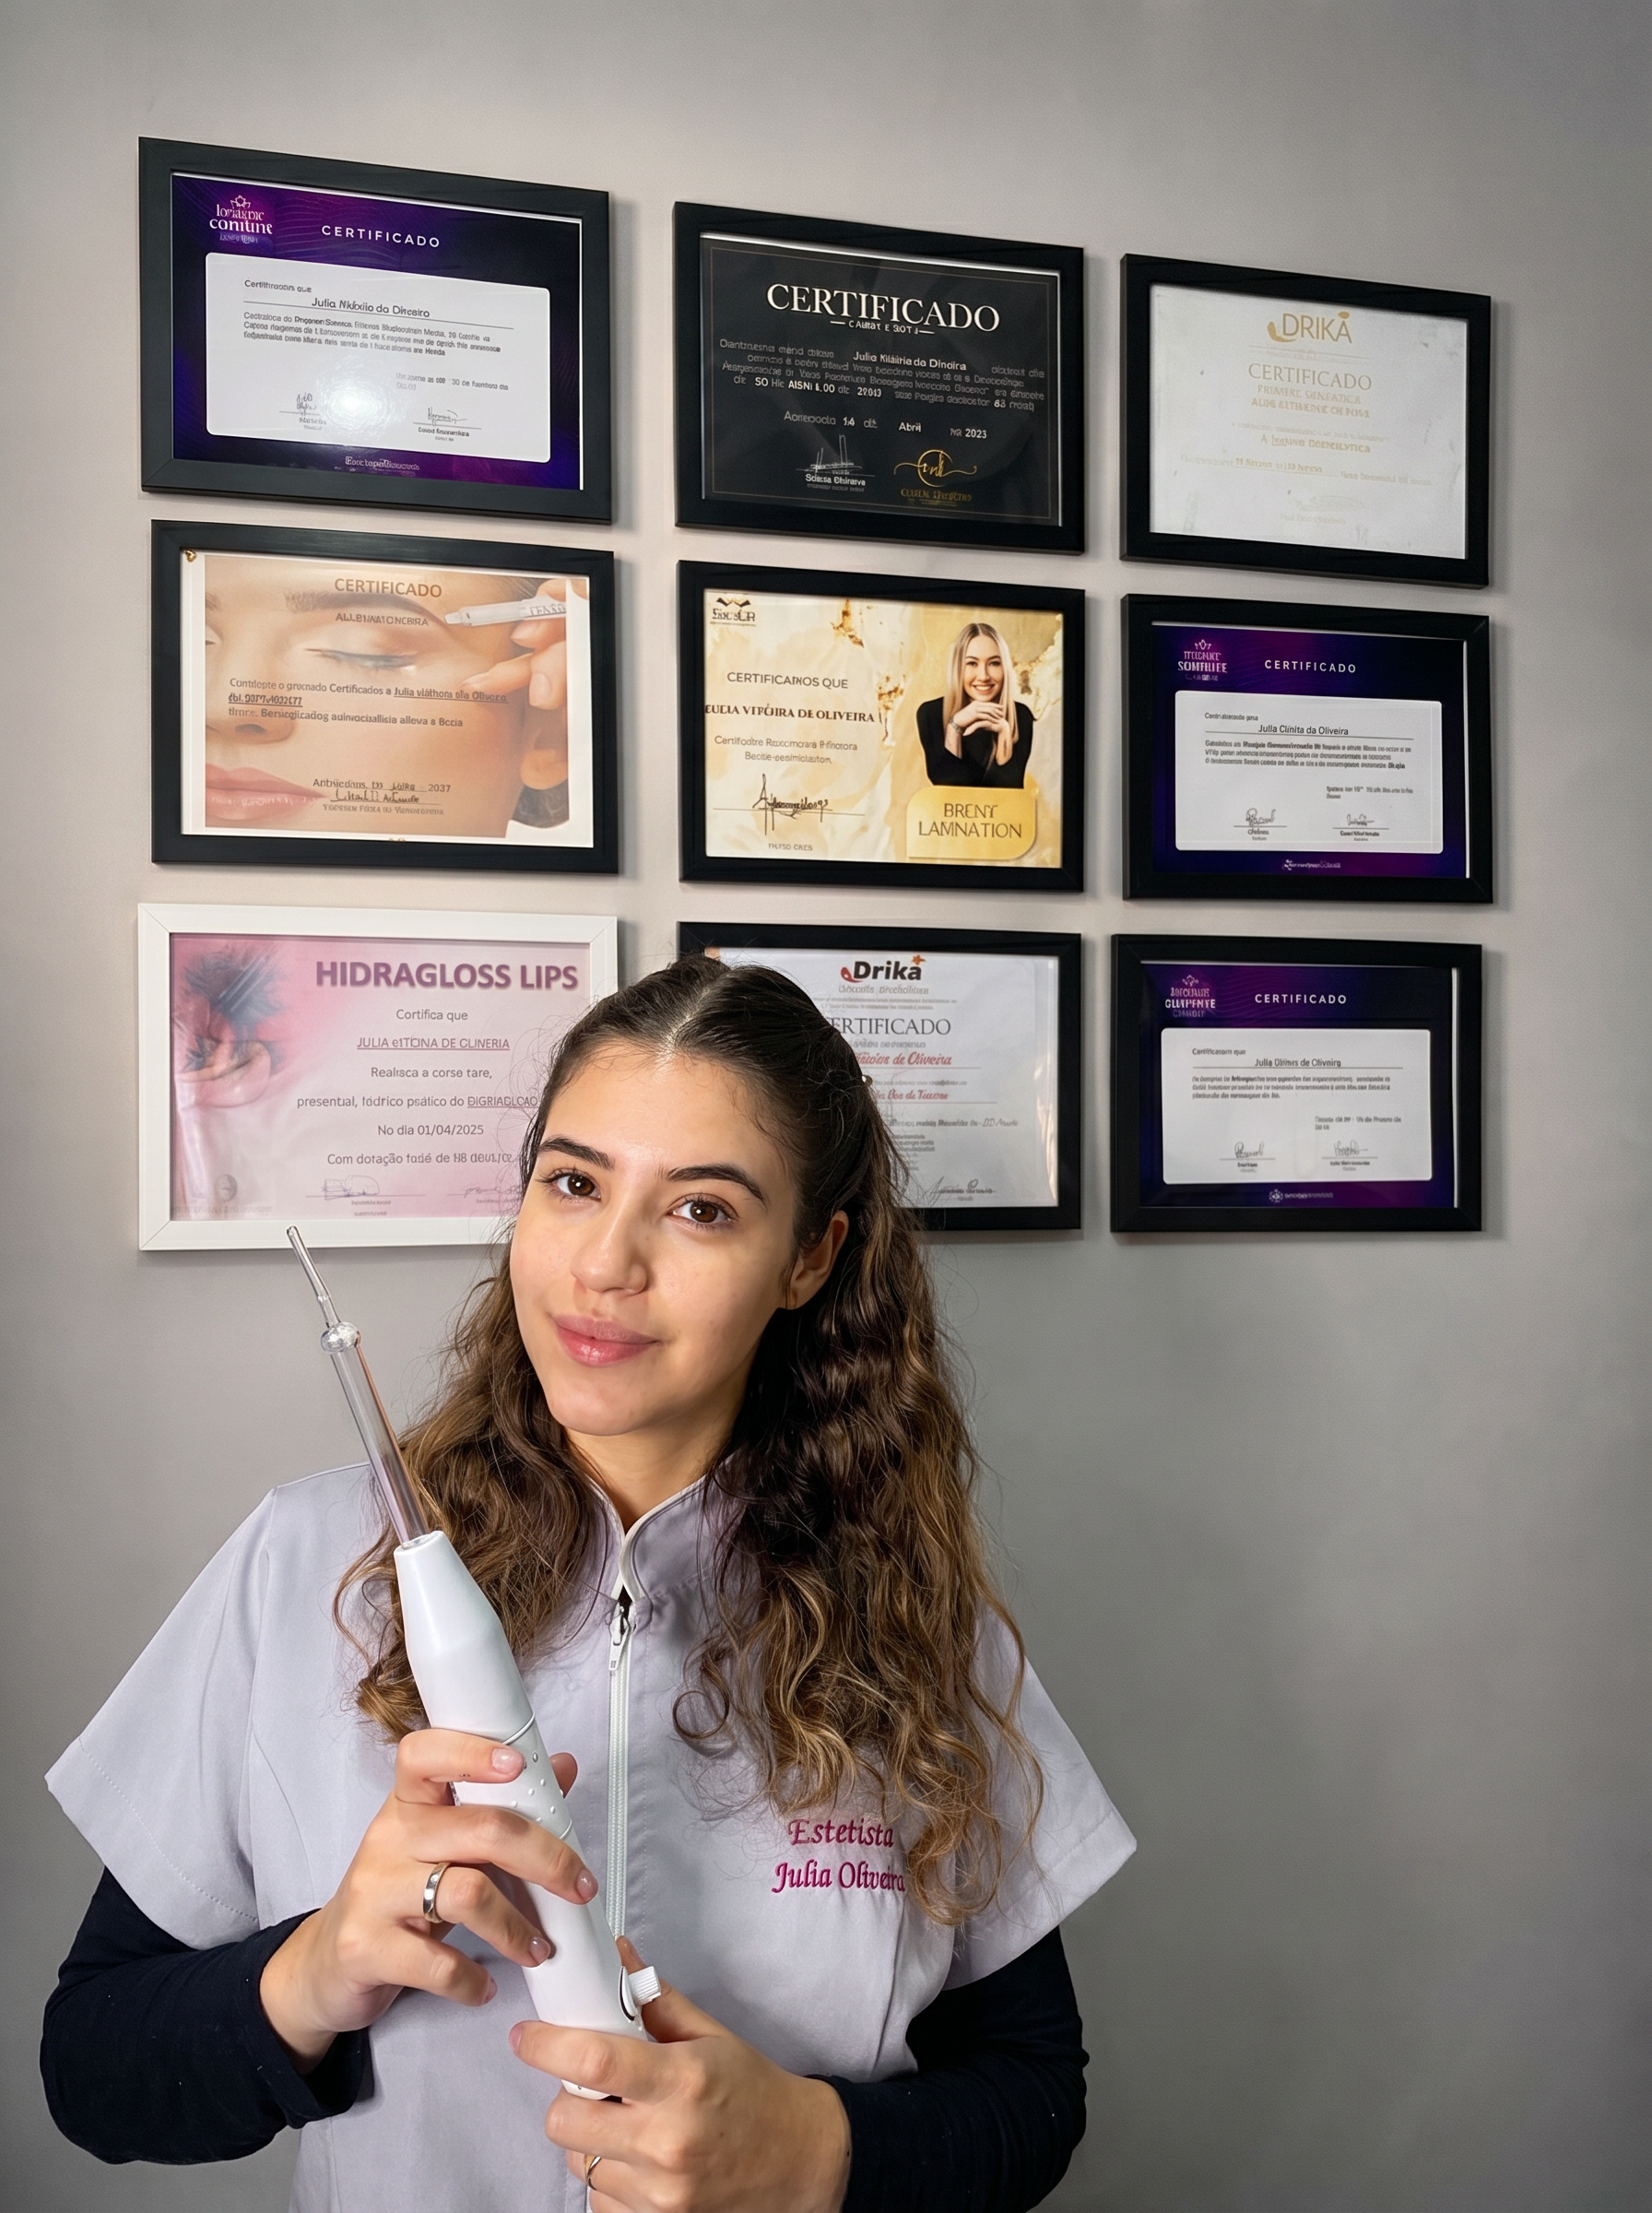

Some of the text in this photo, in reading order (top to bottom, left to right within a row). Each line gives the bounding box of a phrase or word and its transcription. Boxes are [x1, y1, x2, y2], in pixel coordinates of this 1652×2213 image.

[322, 225, 440, 248] CERTIFICADO
[766, 283, 1001, 332] CERTIFICADO
[1282, 313, 1352, 344] DRIKA
[1248, 362, 1373, 391] CERTIFICADO
[964, 428, 987, 440] 2023
[334, 577, 442, 598] CERTIFICADO
[1264, 659, 1356, 674] CERTIFICADO
[329, 683, 384, 695] Certificados
[394, 687, 415, 697] Julia
[822, 678, 848, 690] QUE
[1318, 726, 1349, 736] Oliveira
[428, 784, 452, 793] 2037
[315, 961, 579, 990] HIDRAGLOSS LIPS
[854, 960, 922, 981] Drika
[1255, 993, 1347, 1005] CERTIFICADO
[446, 1011, 468, 1023] que
[826, 1016, 951, 1035] ERTIFICADO
[357, 1037, 389, 1048] JULIA
[442, 1037, 456, 1048] DE
[421, 1069, 430, 1078] a
[449, 1096, 465, 1106] do
[377, 1124, 395, 1136] No
[417, 1124, 484, 1137] 01/04/2025
[327, 1154, 353, 1165] Com
[435, 1153, 450, 1164] de
[788, 1817, 894, 1848] Estetista
[772, 1859, 832, 1893] Julia
